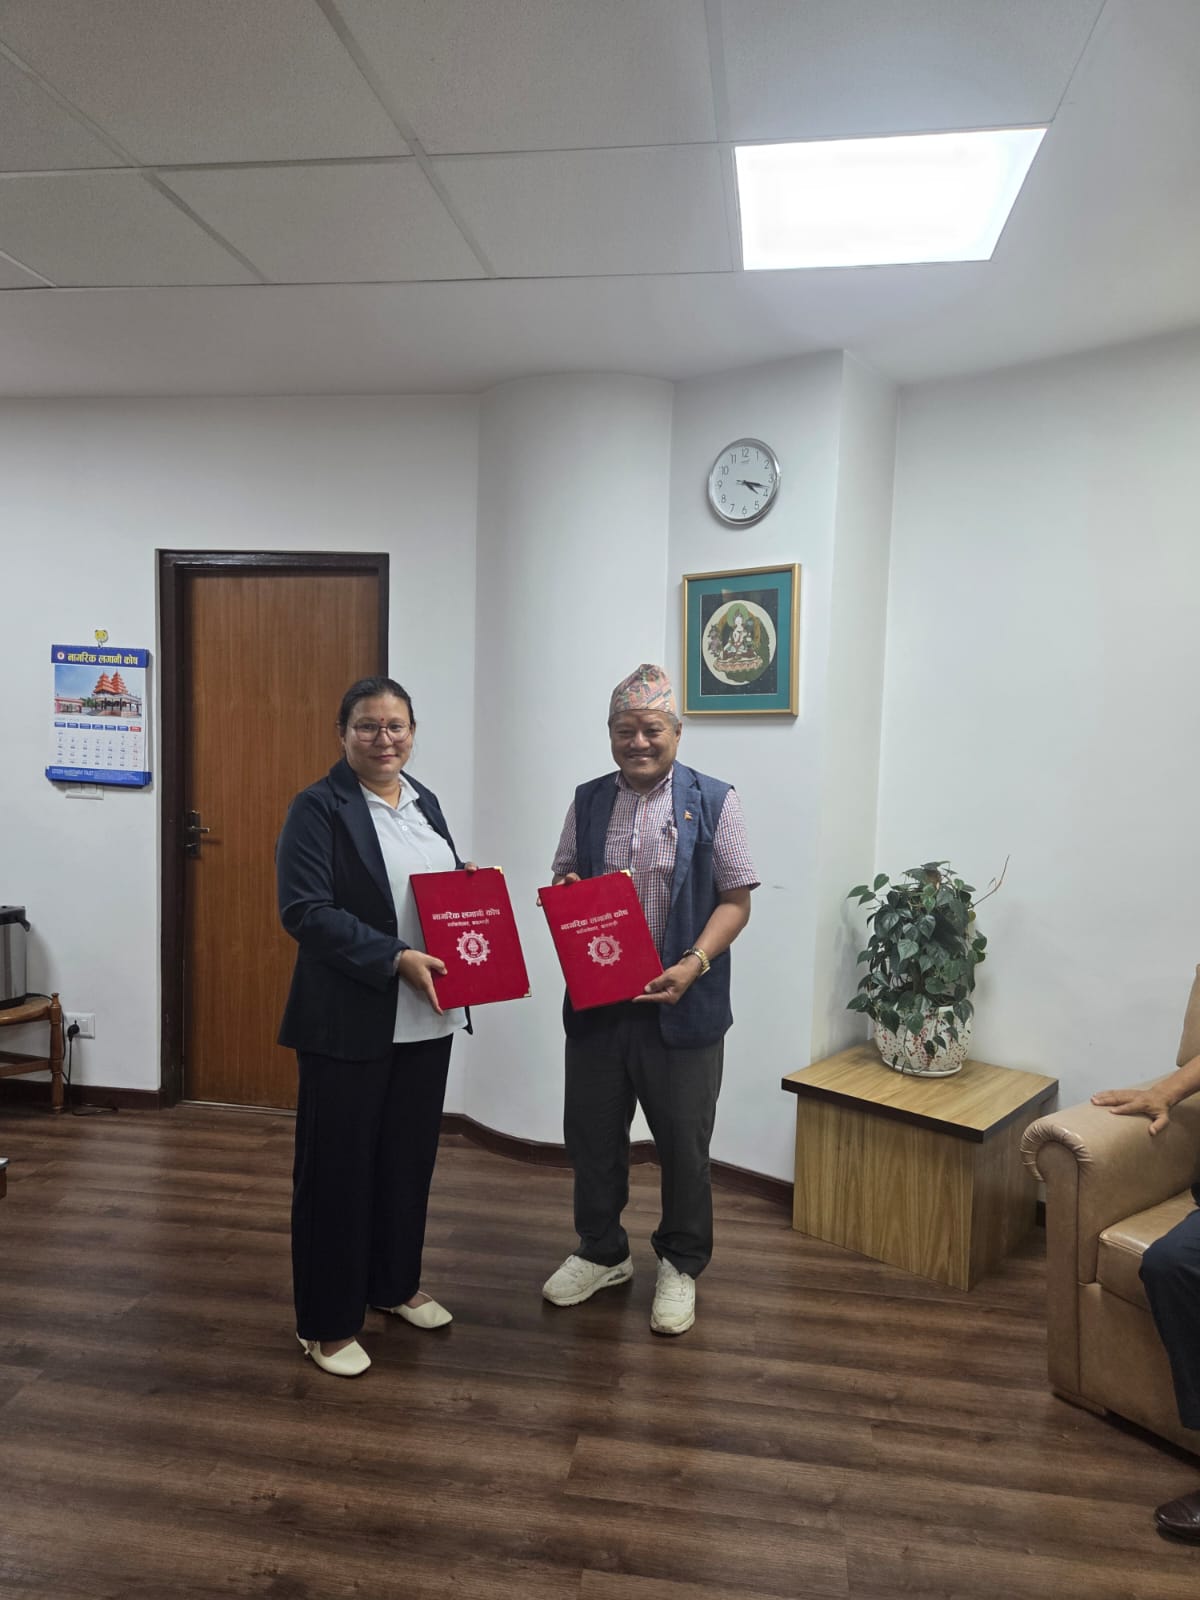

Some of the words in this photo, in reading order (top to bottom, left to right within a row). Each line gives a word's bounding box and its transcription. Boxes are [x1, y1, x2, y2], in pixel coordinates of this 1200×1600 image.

[741, 447, 750, 458] 12
[730, 453, 737, 464] 11
[763, 460, 770, 470] 2
[720, 465, 729, 476] 10
[768, 473, 774, 483] 3
[717, 480, 723, 489] 9
[762, 488, 769, 497] 4
[720, 494, 727, 504] 8
[730, 503, 735, 513] 7
[741, 505, 748, 515] 6
[754, 500, 760, 510] 5
[67, 651, 97, 663] नागरिक
[98, 653, 122, 665] लगानी
[123, 653, 139, 665] कोष
[432, 911, 460, 921] नागरिक
[485, 907, 501, 917] कोष
[560, 919, 589, 931] नागरिक
[613, 908, 629, 919] कोष
